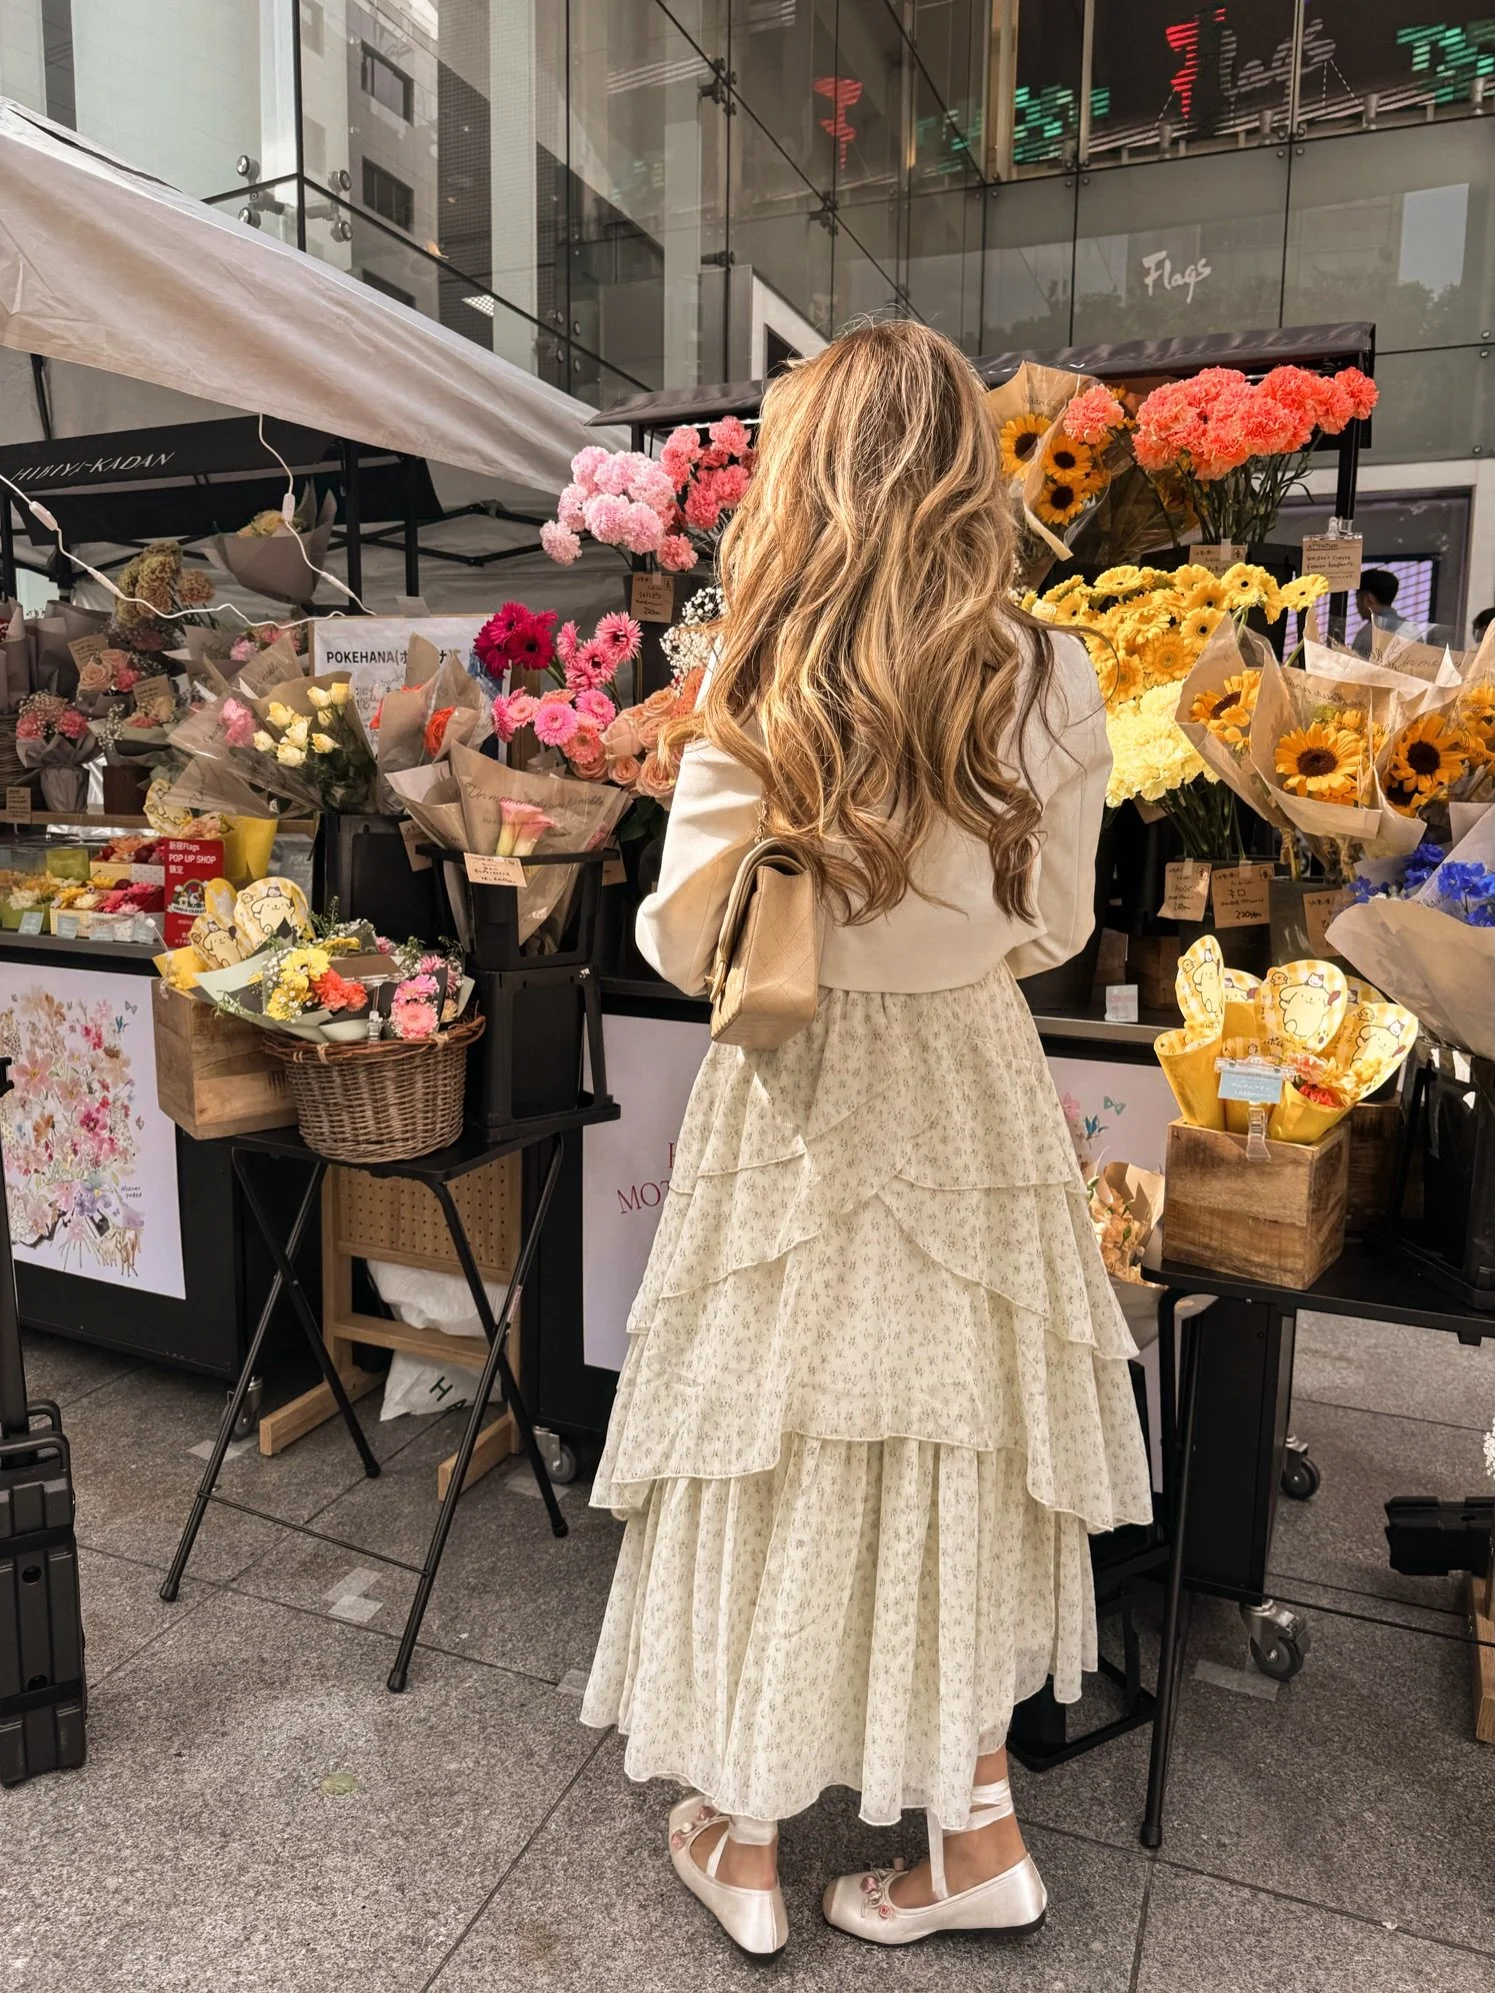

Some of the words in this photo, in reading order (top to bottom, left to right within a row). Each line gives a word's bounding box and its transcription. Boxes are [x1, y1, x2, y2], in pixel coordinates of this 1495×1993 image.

[1142, 250, 1212, 304] Flags
[10, 452, 175, 481] HIBIYA-KADAN
[168, 853, 184, 863] POP
[184, 854, 196, 864] UP
[196, 855, 217, 864] SHOP
